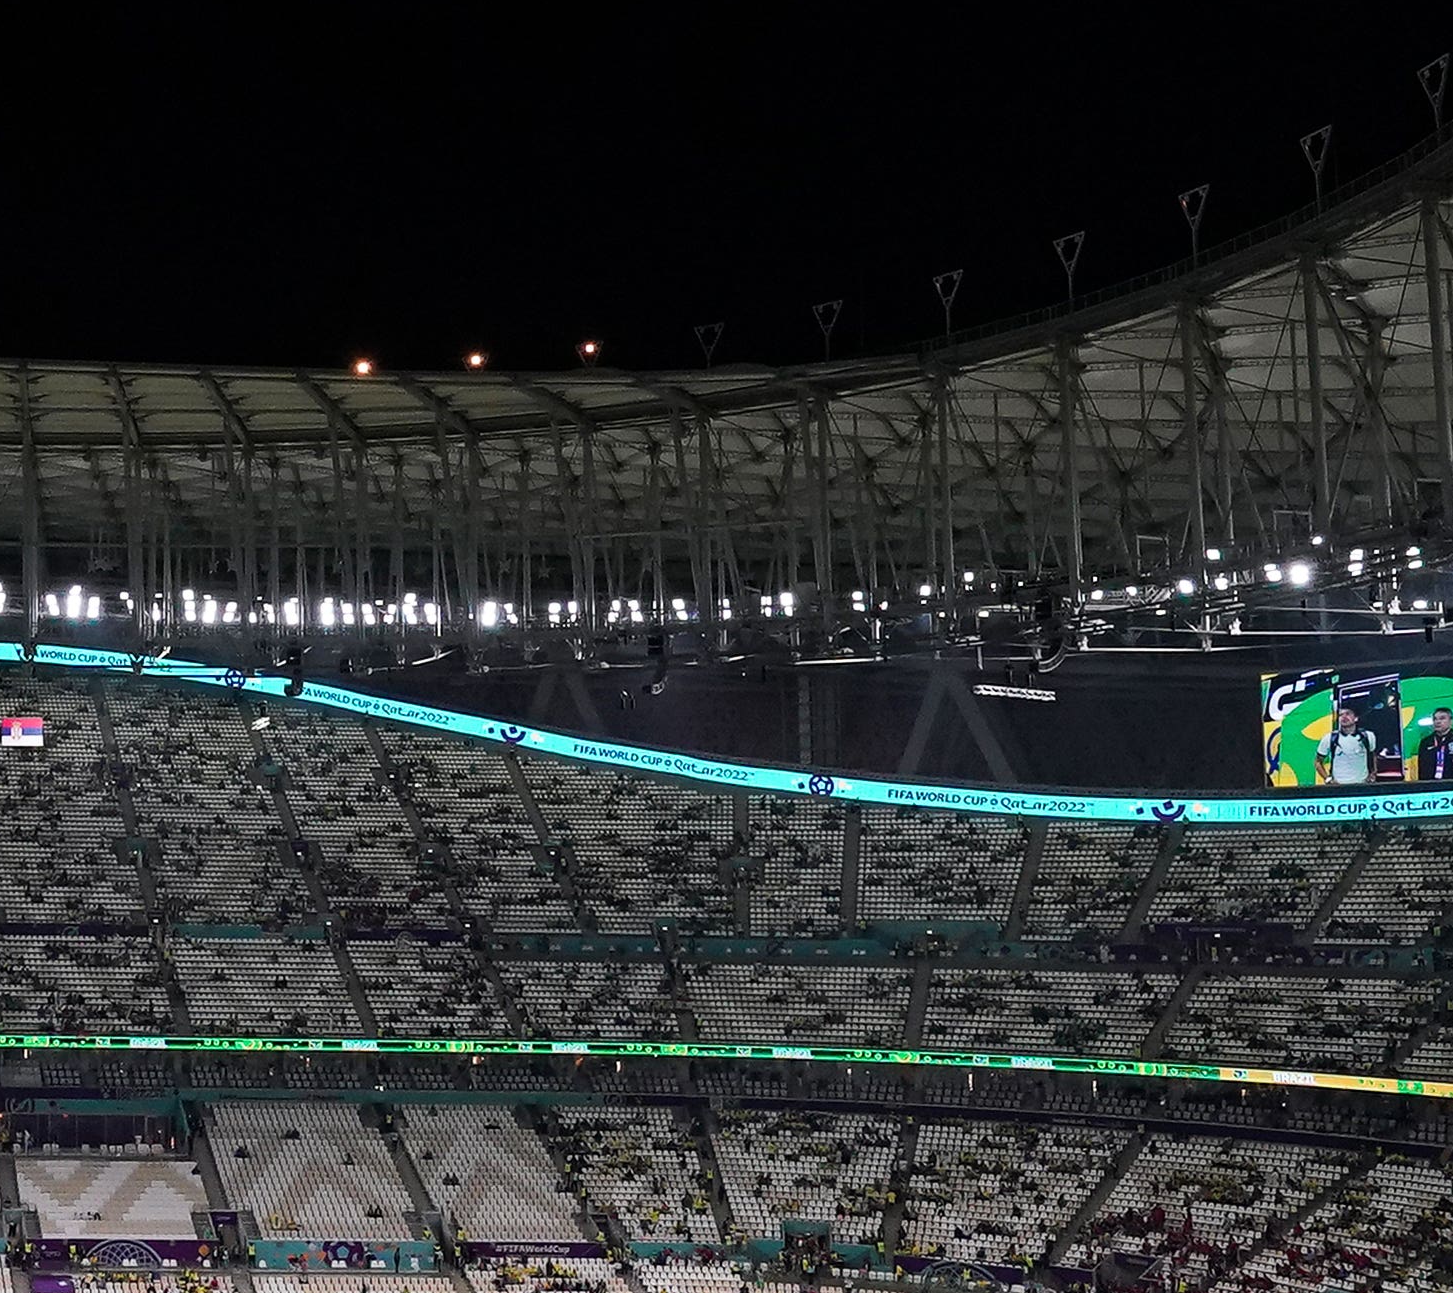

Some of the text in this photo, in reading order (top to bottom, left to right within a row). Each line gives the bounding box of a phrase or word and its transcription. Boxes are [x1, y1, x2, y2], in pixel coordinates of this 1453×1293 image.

[314, 689, 350, 705] WORLD
[352, 698, 372, 709] CUP
[573, 744, 597, 756] FIFA
[599, 748, 639, 762] WORLD
[641, 754, 662, 766] CUP
[887, 788, 913, 800] FIFA
[915, 791, 961, 804] WORLD
[963, 795, 988, 806] CUP
[1250, 806, 1279, 817] FIFA
[1280, 803, 1334, 816] WORLD
[1337, 802, 1366, 814] CUP
